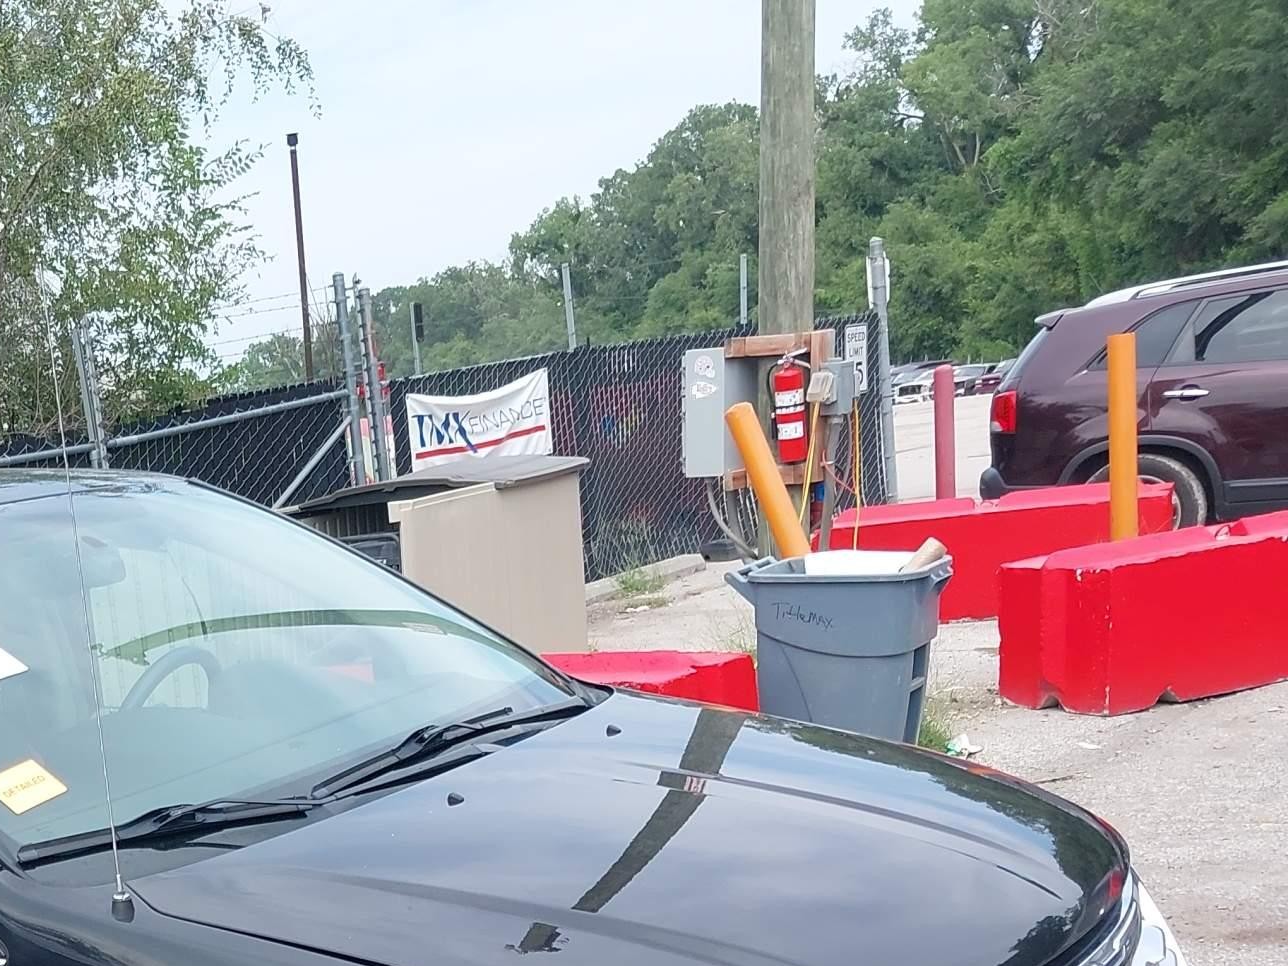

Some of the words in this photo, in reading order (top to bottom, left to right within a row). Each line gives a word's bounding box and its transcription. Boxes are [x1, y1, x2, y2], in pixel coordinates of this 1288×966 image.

[847, 331, 866, 344] SPEED
[848, 346, 864, 358] LIMIT
[412, 410, 479, 454] TMX
[468, 397, 545, 435] FINANCE
[2, 775, 46, 798] DETAILED
